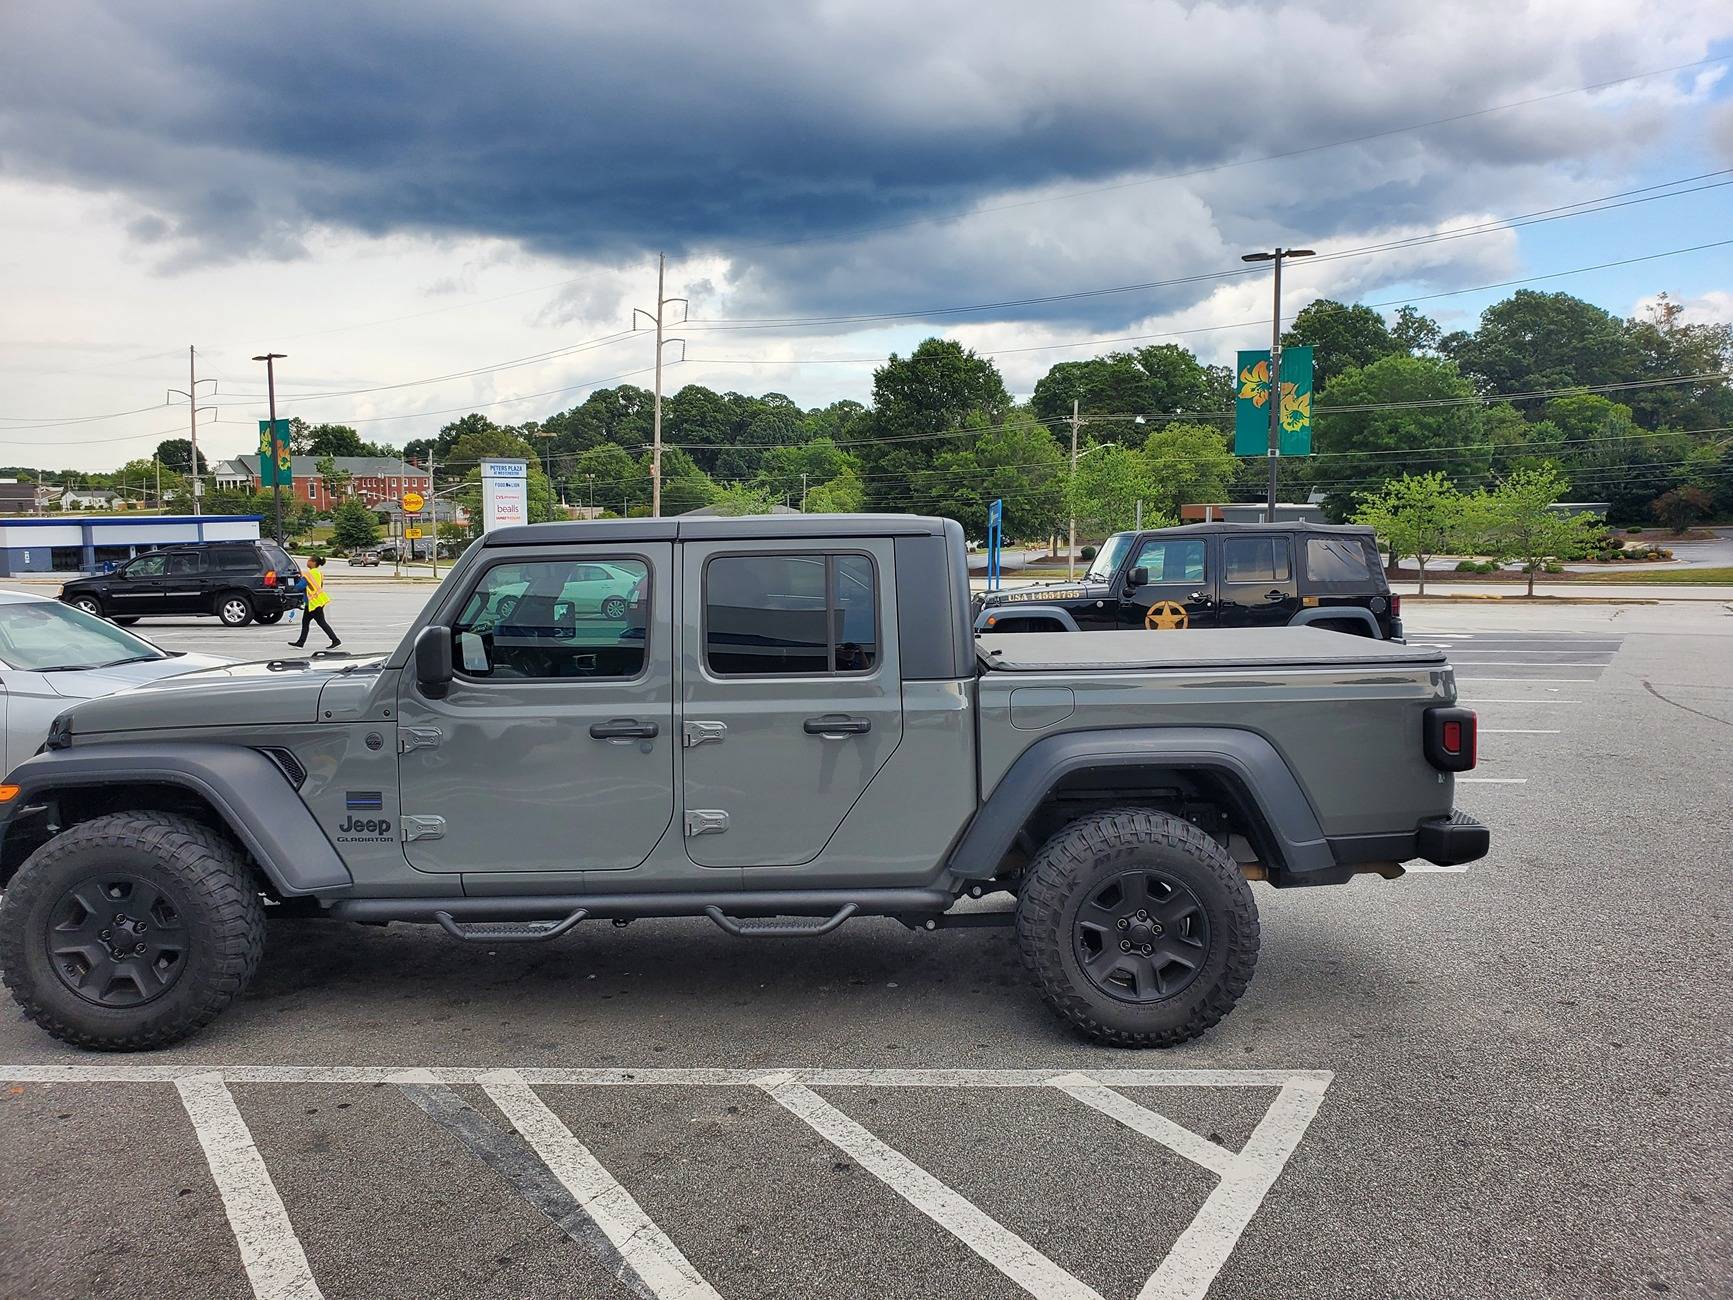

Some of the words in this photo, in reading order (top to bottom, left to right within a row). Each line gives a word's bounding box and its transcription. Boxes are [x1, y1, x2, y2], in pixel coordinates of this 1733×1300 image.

[496, 504, 519, 513] bealls
[1008, 593, 1029, 602] USA
[339, 815, 391, 836] Jeep
